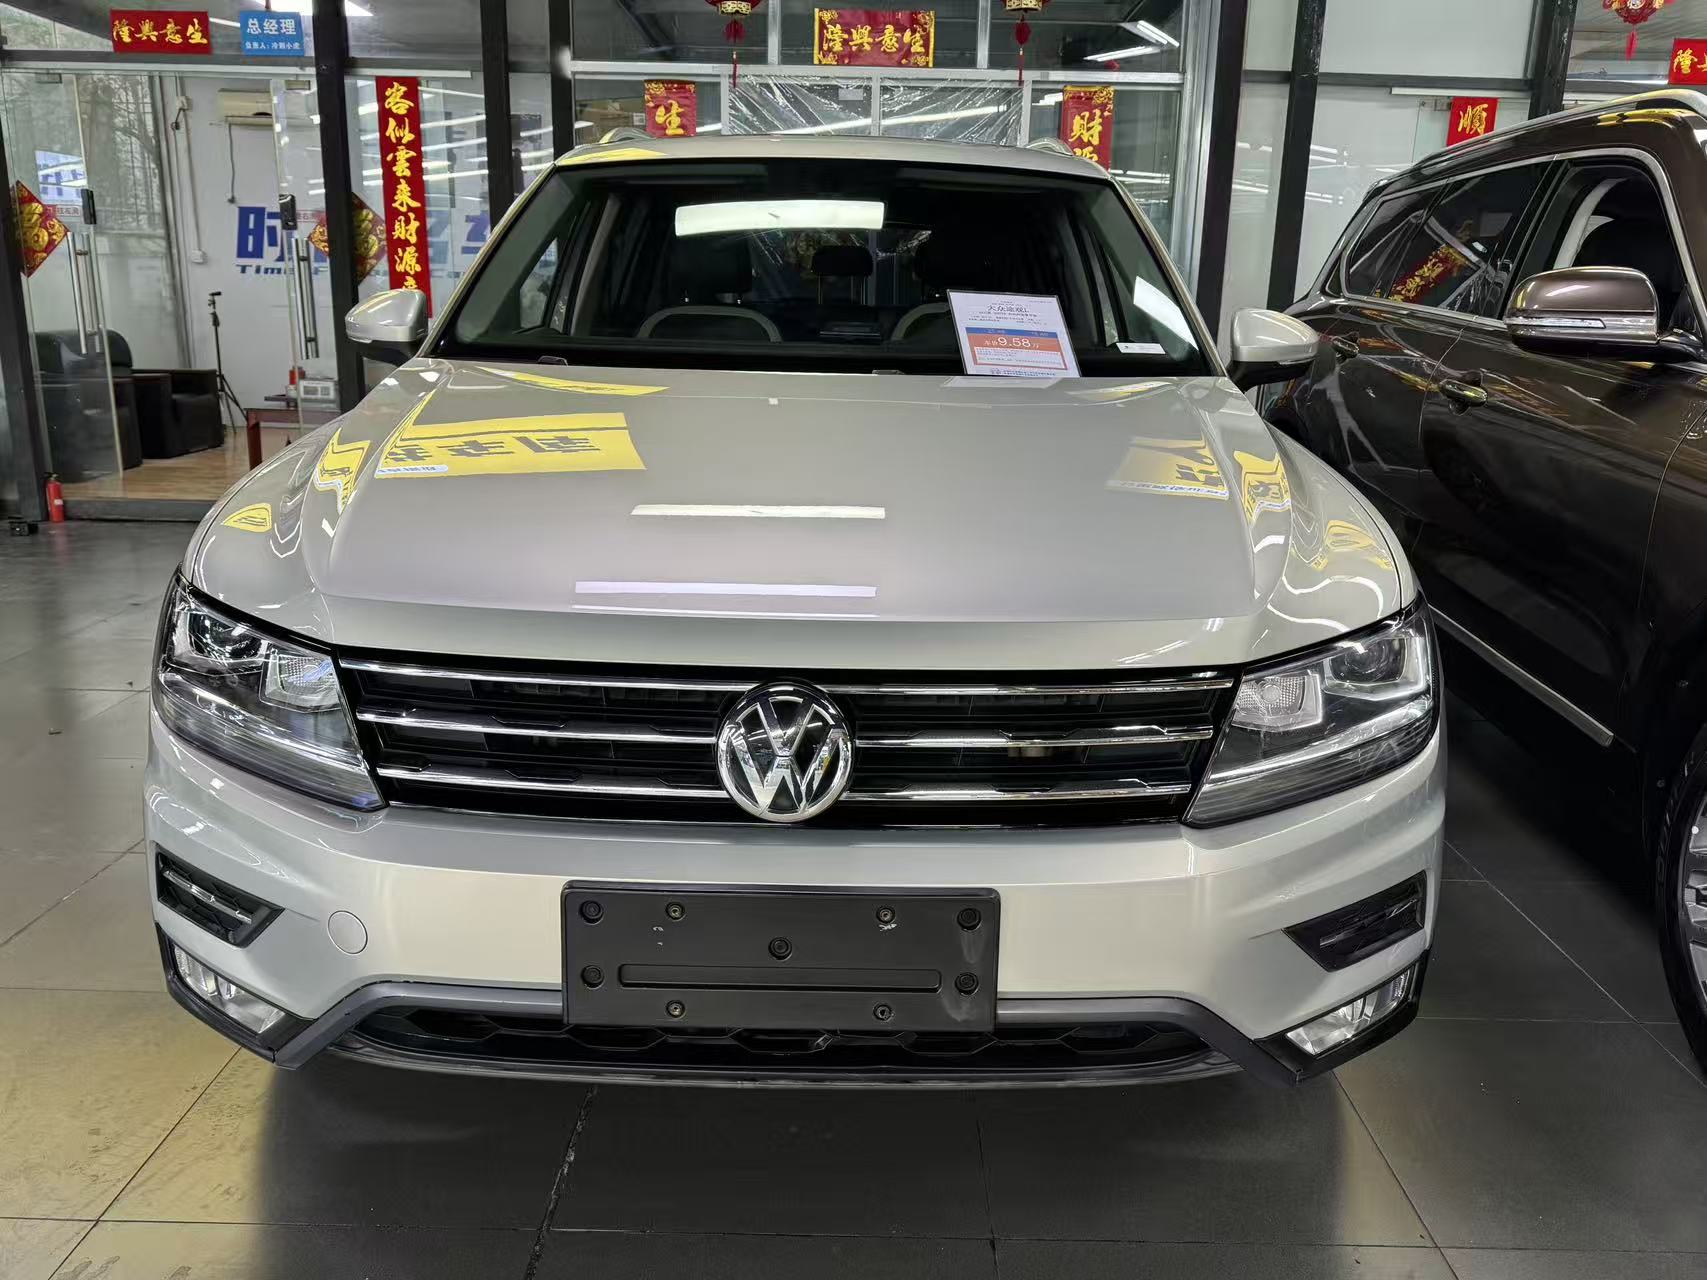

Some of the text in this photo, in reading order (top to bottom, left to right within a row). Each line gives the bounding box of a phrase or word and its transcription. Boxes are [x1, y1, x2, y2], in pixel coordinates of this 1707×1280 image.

[247, 18, 297, 35] 总经理
[655, 100, 684, 135] 生
